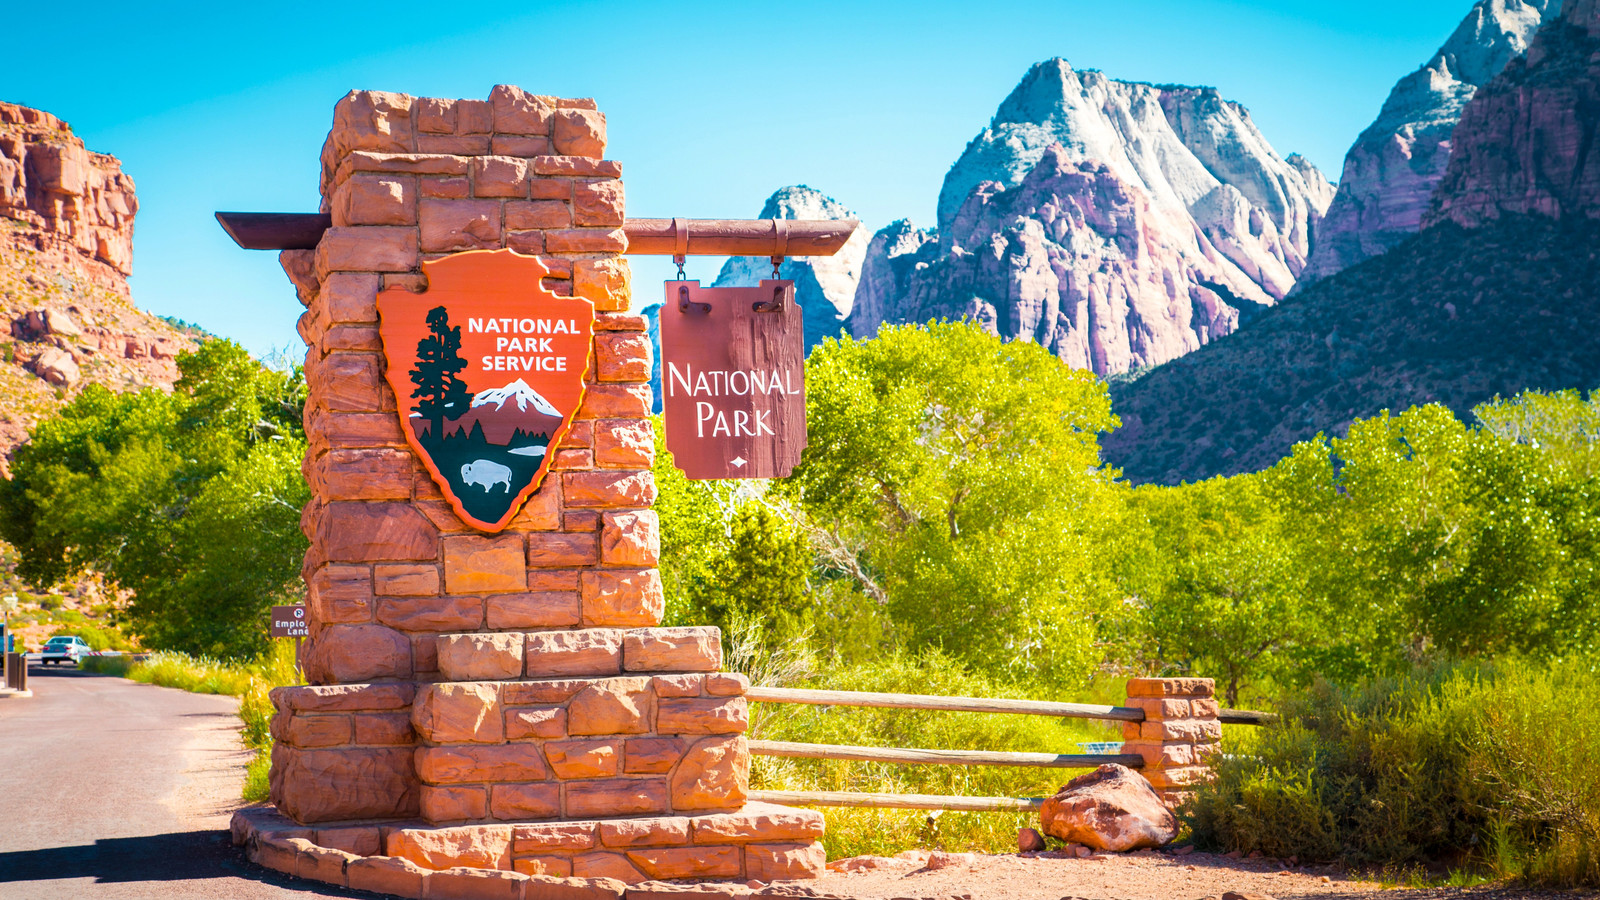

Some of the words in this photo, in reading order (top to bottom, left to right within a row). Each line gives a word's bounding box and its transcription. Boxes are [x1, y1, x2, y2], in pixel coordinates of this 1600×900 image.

[468, 317, 581, 334] NATIONAL
[496, 337, 555, 353] PARK
[482, 356, 568, 372] SERVICE
[668, 361, 800, 397] NATIONAL
[697, 402, 775, 438] PARK
[275, 620, 308, 630] Emplo
